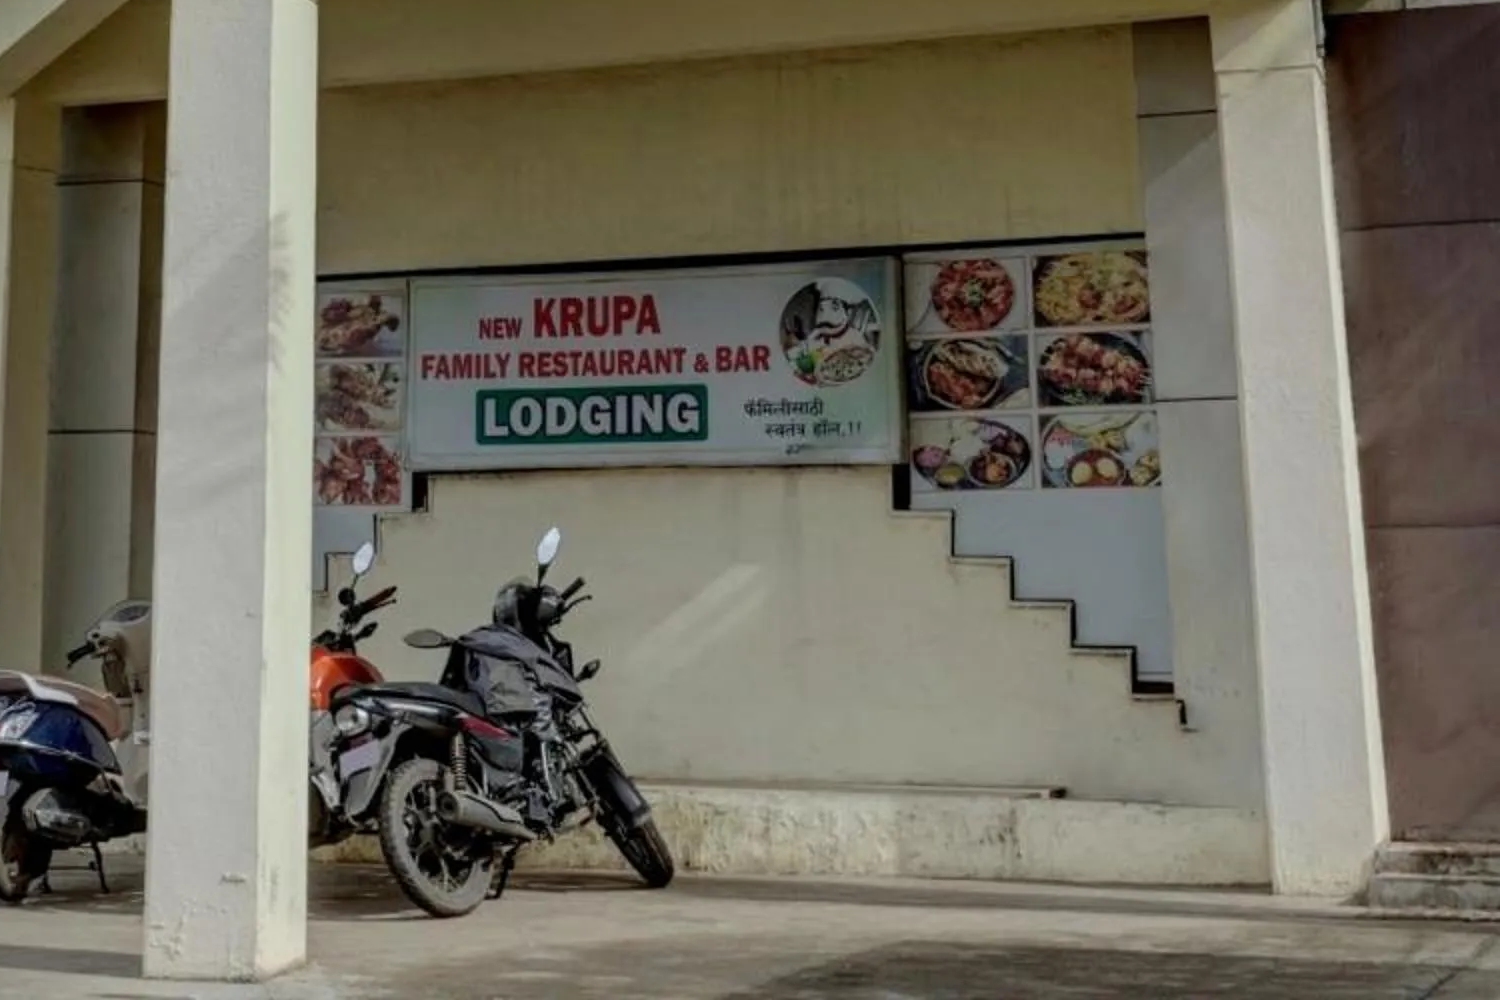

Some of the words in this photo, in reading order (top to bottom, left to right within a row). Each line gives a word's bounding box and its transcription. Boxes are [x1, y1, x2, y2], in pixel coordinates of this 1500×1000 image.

[478, 317, 522, 340] NEW
[533, 294, 661, 339] KRUPA
[421, 352, 510, 380] FAMILY
[518, 347, 687, 378] RESTAURANT
[693, 353, 709, 373] &
[715, 345, 771, 373] BAR
[483, 392, 701, 437] LODGING
